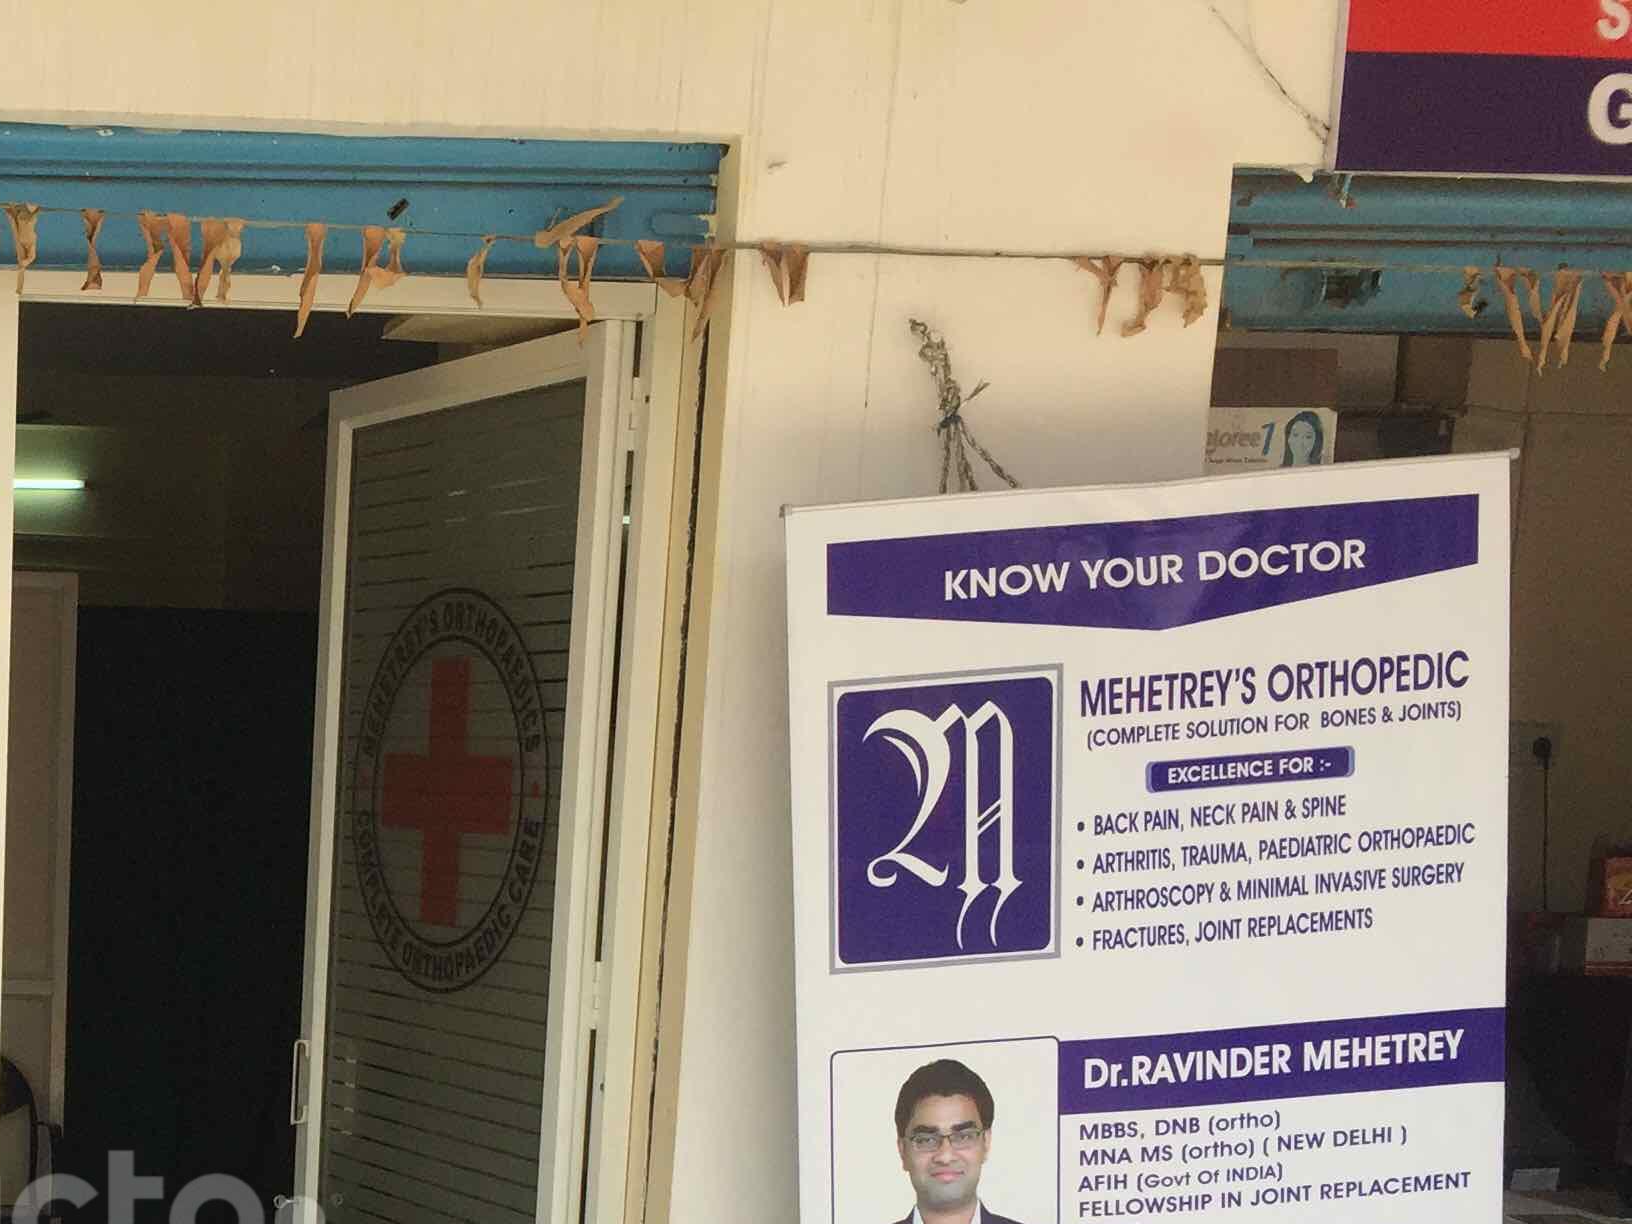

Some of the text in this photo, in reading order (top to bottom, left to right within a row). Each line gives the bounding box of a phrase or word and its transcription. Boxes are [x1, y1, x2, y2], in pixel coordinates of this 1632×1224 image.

[944, 539, 1366, 601] KNOW YOUR DOCTOR
[1080, 650, 1469, 717] MEHETREY'S ORTHOPEDIC
[1087, 700, 1461, 751] (COMPLETE SOLUTION FOR BONES & JOINTS)
[1167, 758, 1273, 784] EXCELLENCE
[1279, 756, 1314, 775] FOR
[1093, 794, 1346, 835] BACK PAIN, NECK PAIN & SPINE
[1092, 822, 1475, 875] ARTHRITIS, TRAUMA, PAEDIATRIC ORTHOPAEDIC
[1092, 862, 1465, 913] ARTHROSCOPY & MINIMAL INVASIVE SURGERY
[1092, 907, 1374, 951] FRACTURES, JOINT REPLACEMENTS
[1083, 1028, 1465, 1089] Dr.RAVINDER MEHETREY
[1079, 1110, 1281, 1141] MBBS, DNB (ortho)
[1079, 1146, 1133, 1167] MNA
[1140, 1143, 1173, 1163] MS
[1181, 1137, 1255, 1164] (ortho)
[1276, 1132, 1326, 1153] NEW
[1333, 1127, 1393, 1148] DELHI
[1078, 1161, 1284, 1194] AFIH (Govt Of INDIA)
[1079, 1171, 1471, 1218] FELLOWSHIP IN JOINT REPLACEMENT
